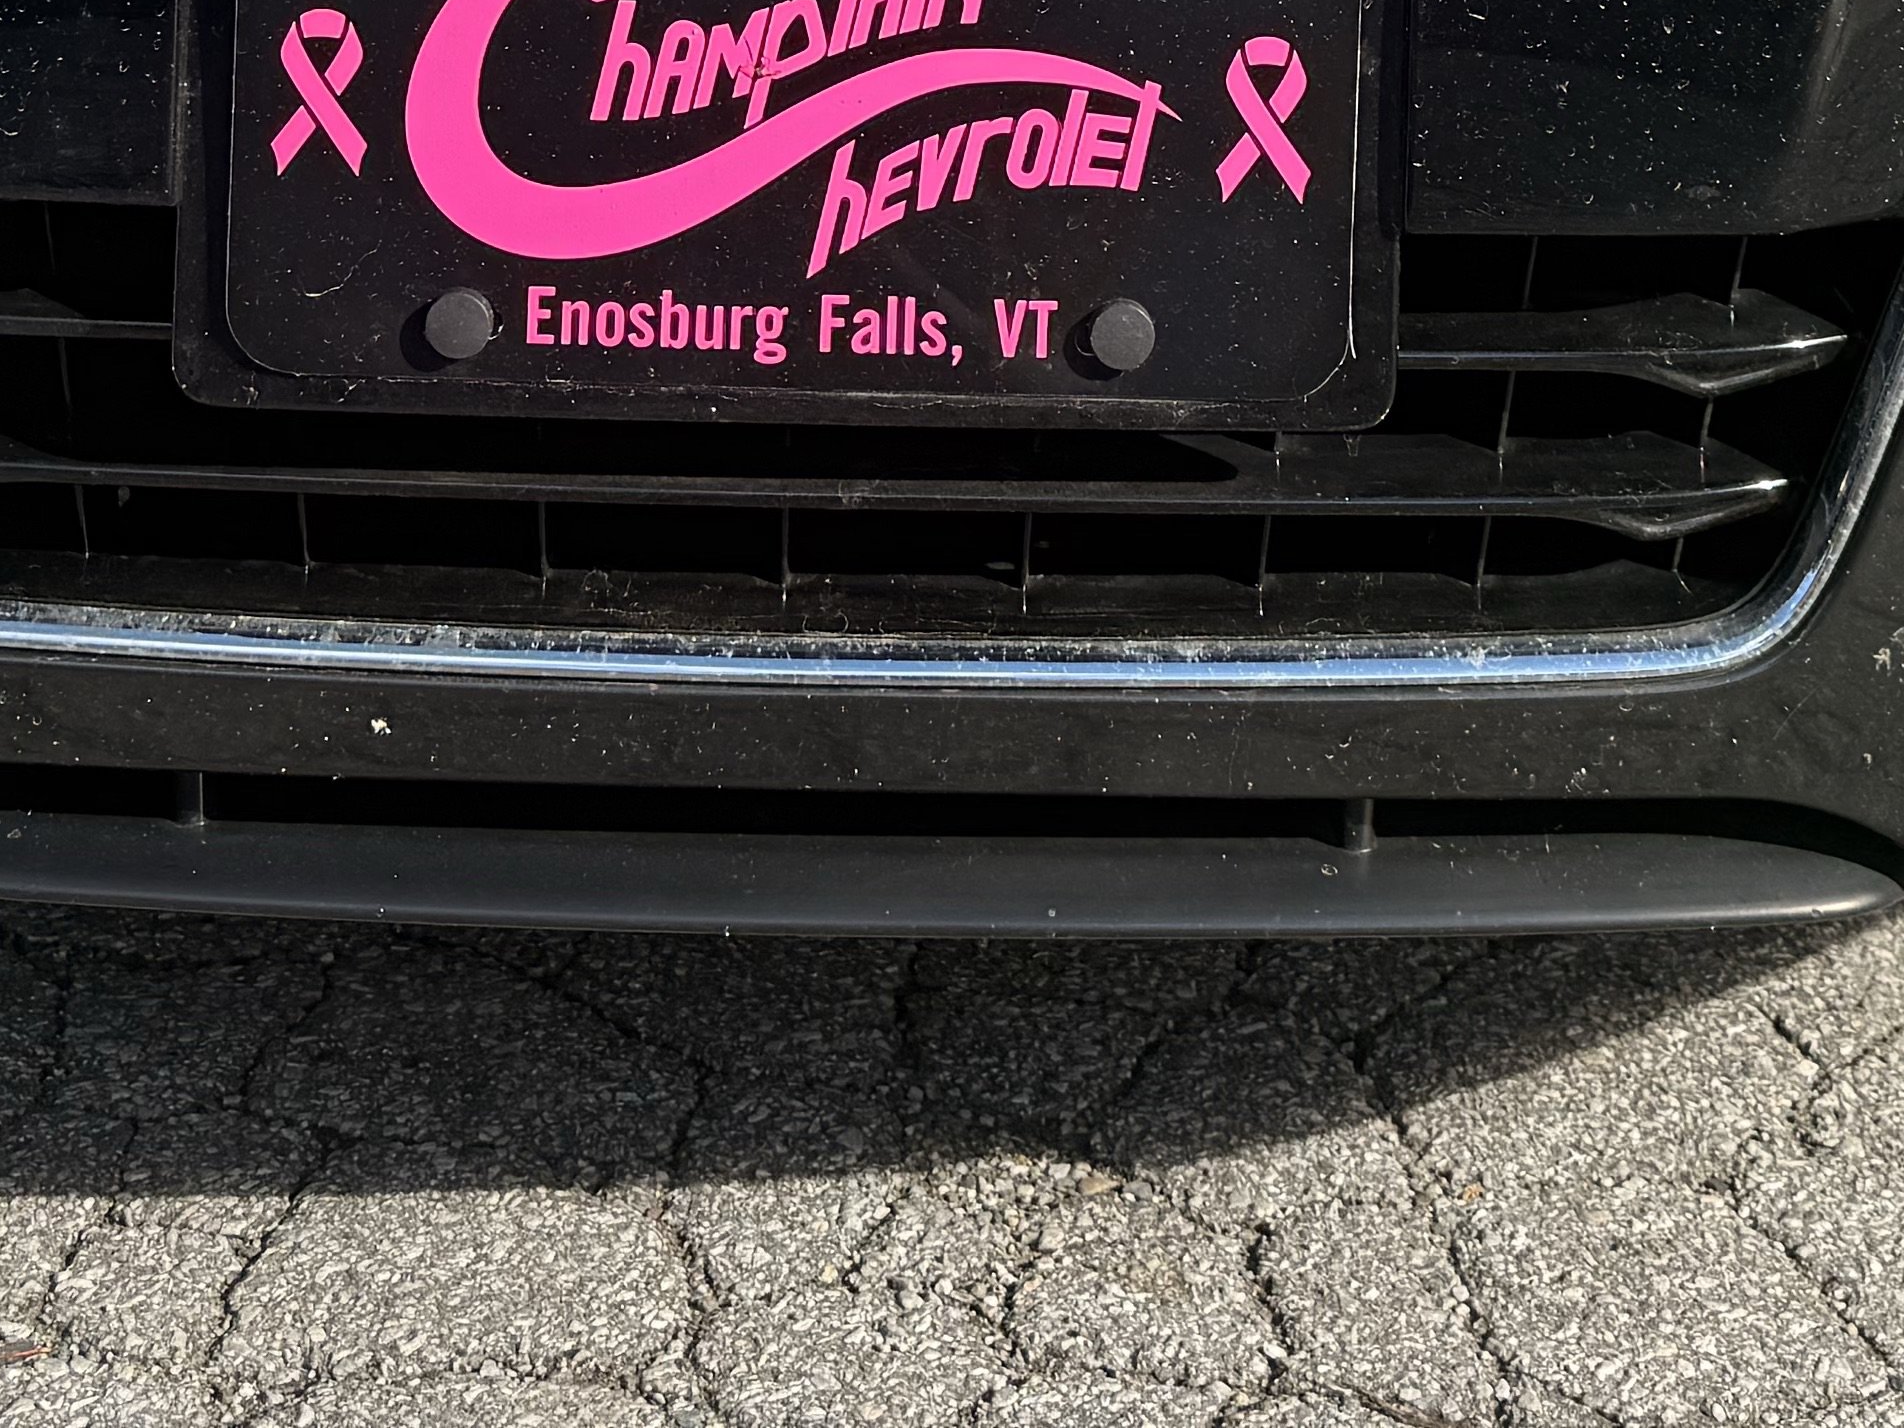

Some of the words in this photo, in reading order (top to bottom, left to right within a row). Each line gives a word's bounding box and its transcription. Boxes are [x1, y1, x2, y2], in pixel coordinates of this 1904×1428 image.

[524, 286, 789, 365] Enosburg
[818, 294, 964, 367] Falls,
[994, 299, 1059, 359] VT
